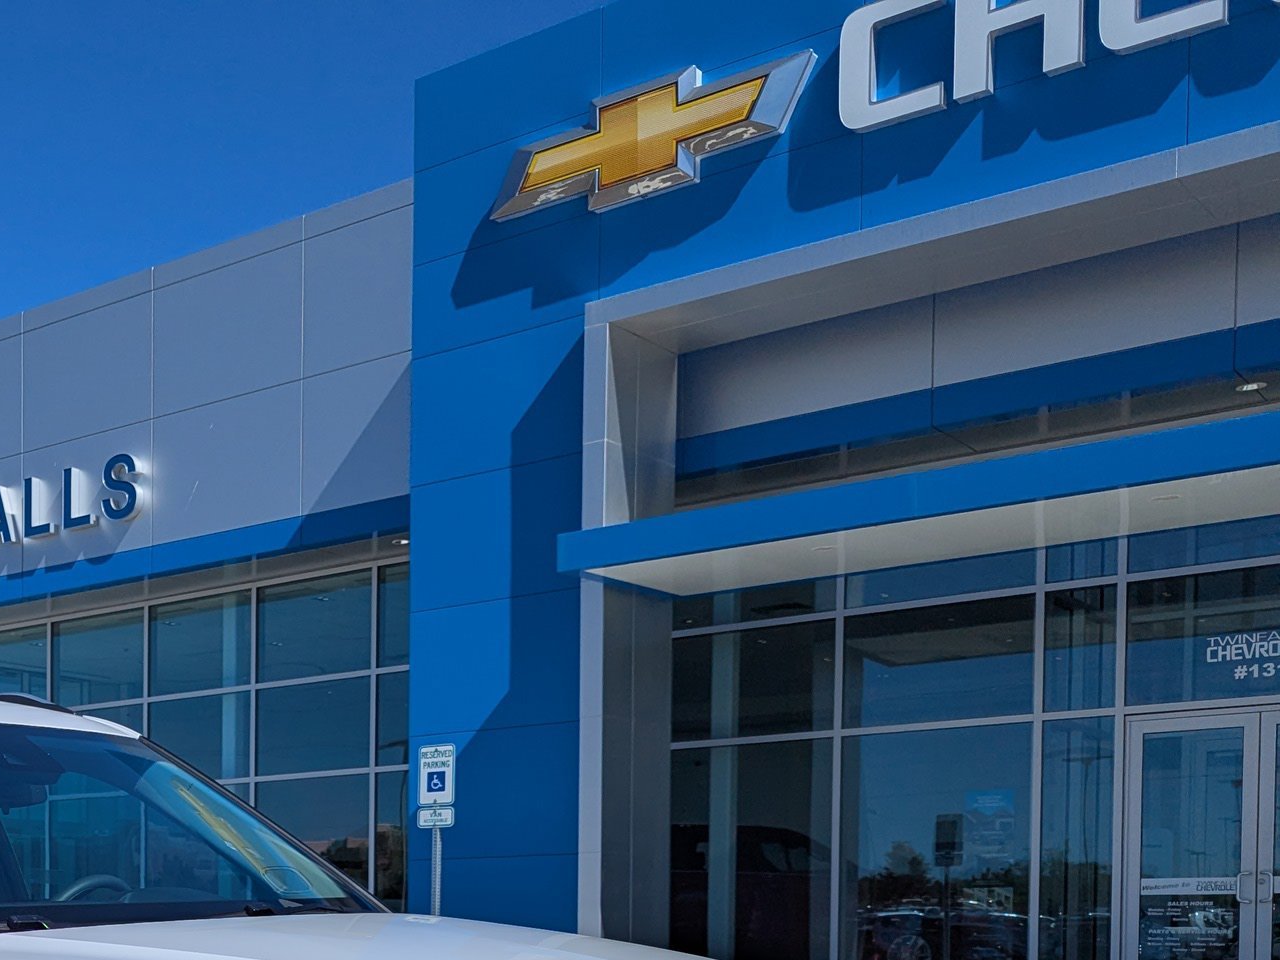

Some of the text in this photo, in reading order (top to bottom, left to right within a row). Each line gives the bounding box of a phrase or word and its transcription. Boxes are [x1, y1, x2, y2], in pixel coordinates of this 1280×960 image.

[1234, 663, 1280, 680] #13
[421, 749, 452, 760] RESERVED
[423, 760, 451, 769] PARKING
